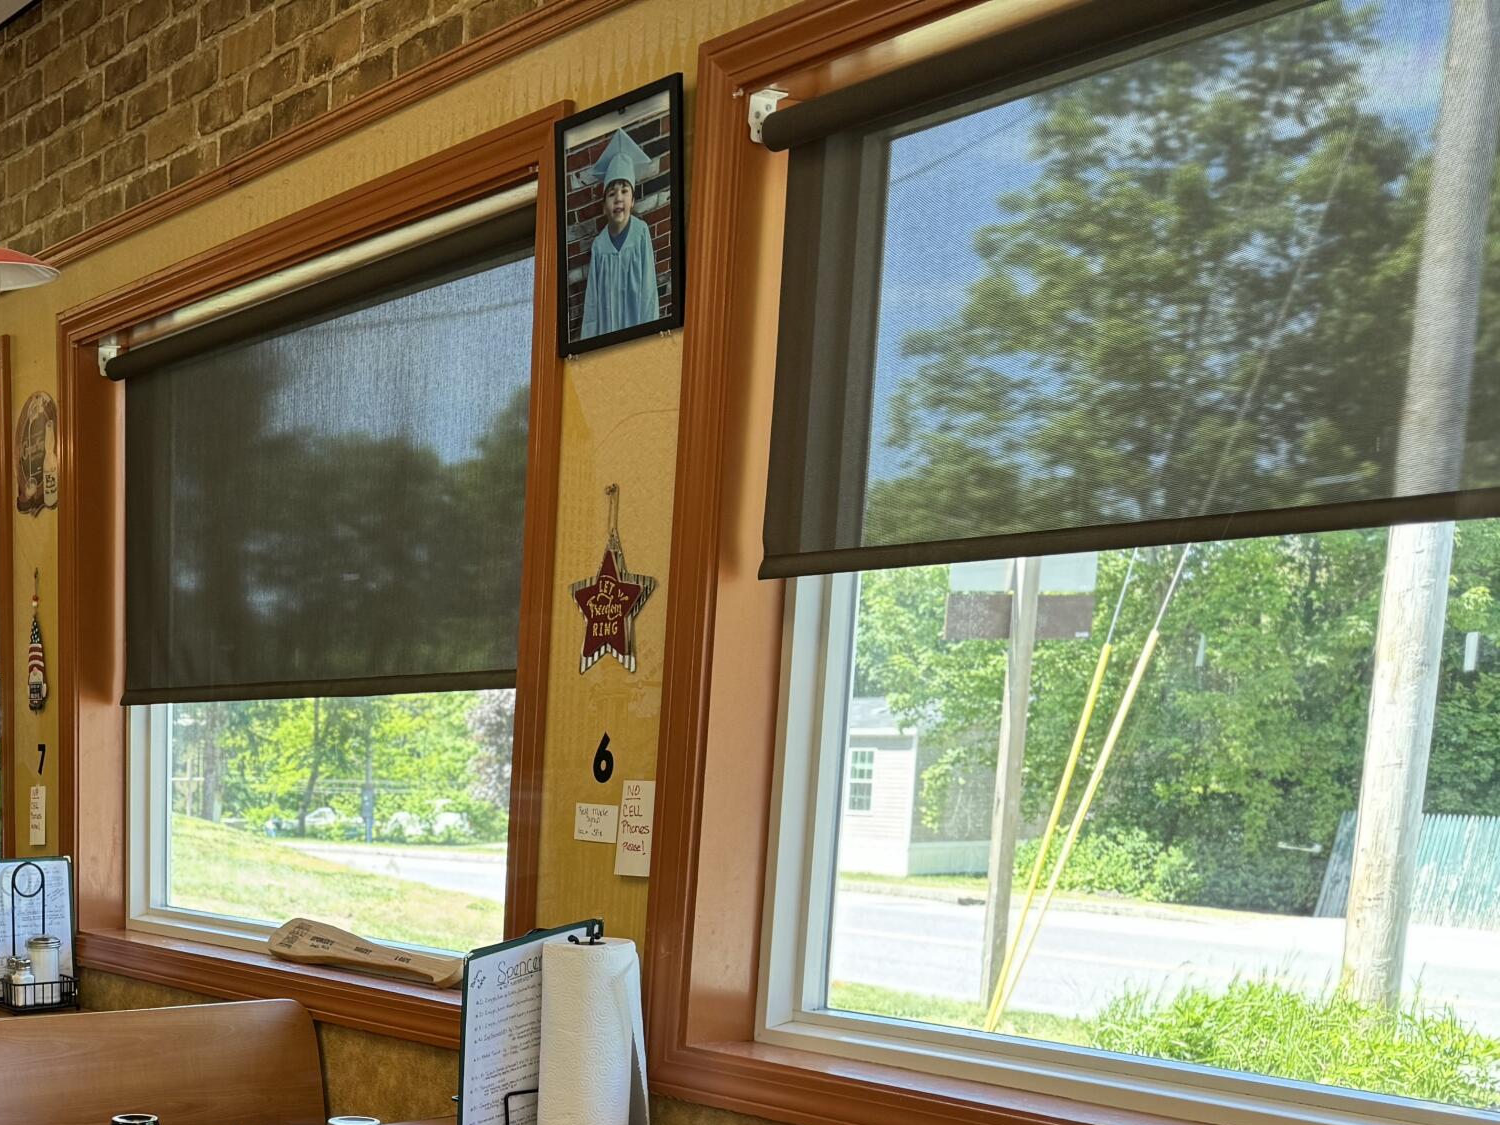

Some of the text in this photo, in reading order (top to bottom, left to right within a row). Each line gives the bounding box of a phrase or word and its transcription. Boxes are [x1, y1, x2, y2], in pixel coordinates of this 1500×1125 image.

[598, 580, 615, 596] LET
[592, 621, 618, 638] RING
[37, 743, 46, 776] 7
[593, 731, 614, 784] 6
[626, 785, 641, 796] NO
[622, 805, 643, 817] CELL
[621, 820, 650, 835] Phones
